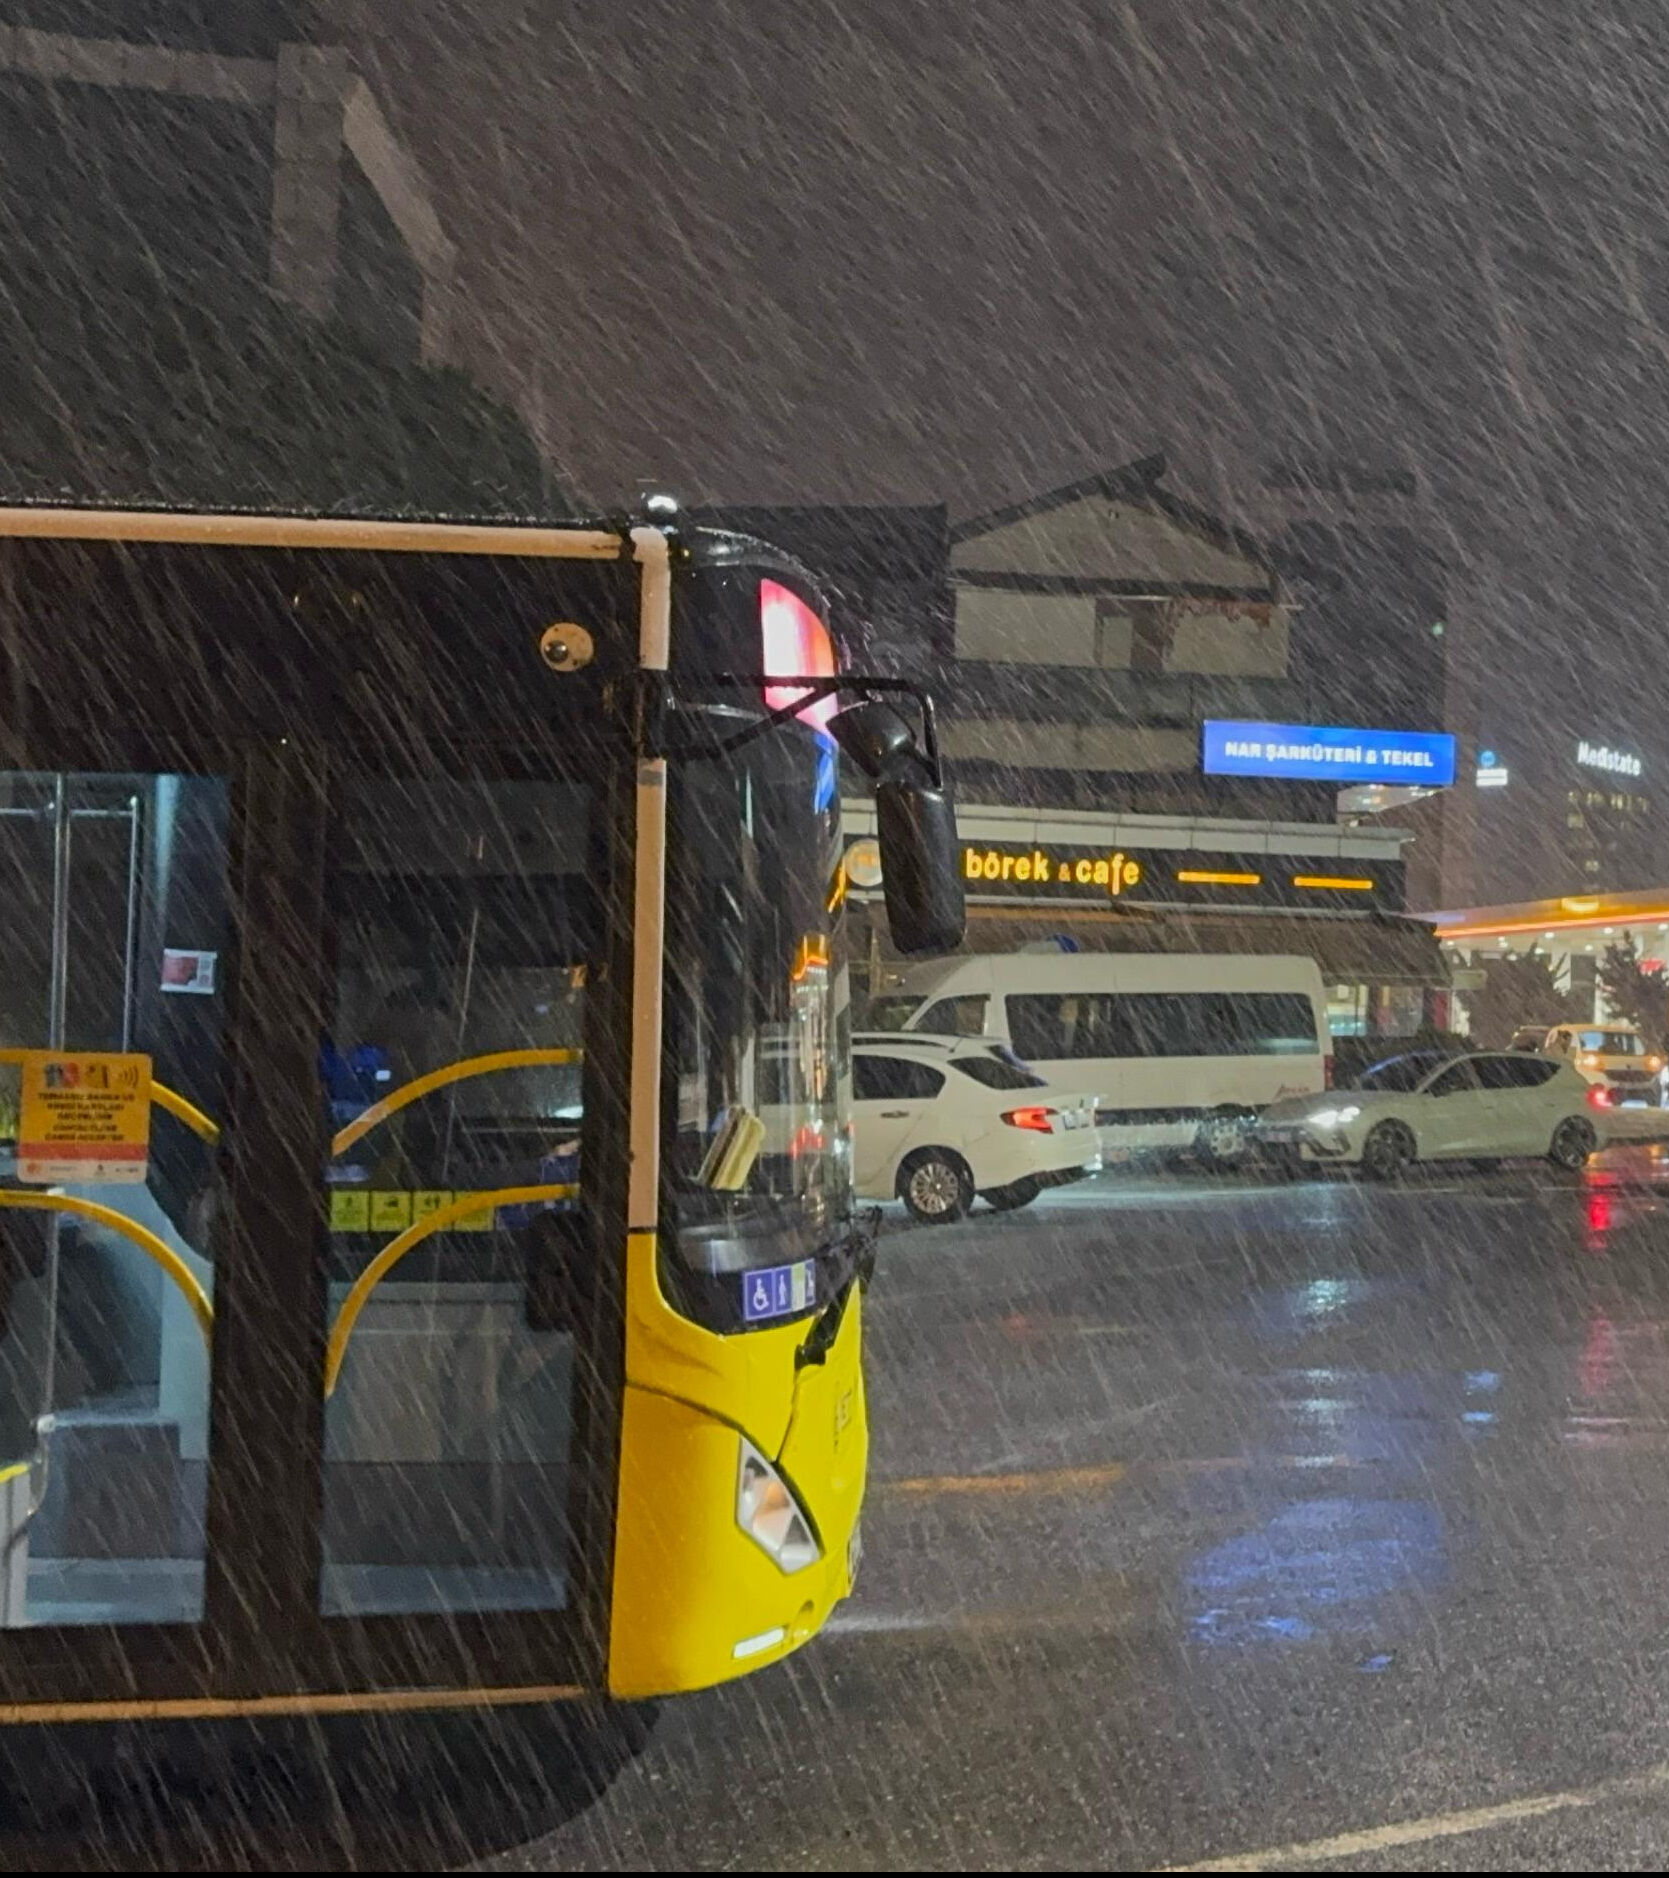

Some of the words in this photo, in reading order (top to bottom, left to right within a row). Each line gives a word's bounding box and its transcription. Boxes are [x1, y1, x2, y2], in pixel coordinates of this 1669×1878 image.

[1225, 741, 1261, 758] NAR
[1266, 743, 1362, 763] ŞARKÜTERİ
[1365, 750, 1377, 764] &
[1381, 750, 1434, 767] TEKEL
[1058, 862, 1071, 882] &
[1075, 853, 1140, 896] cafe
